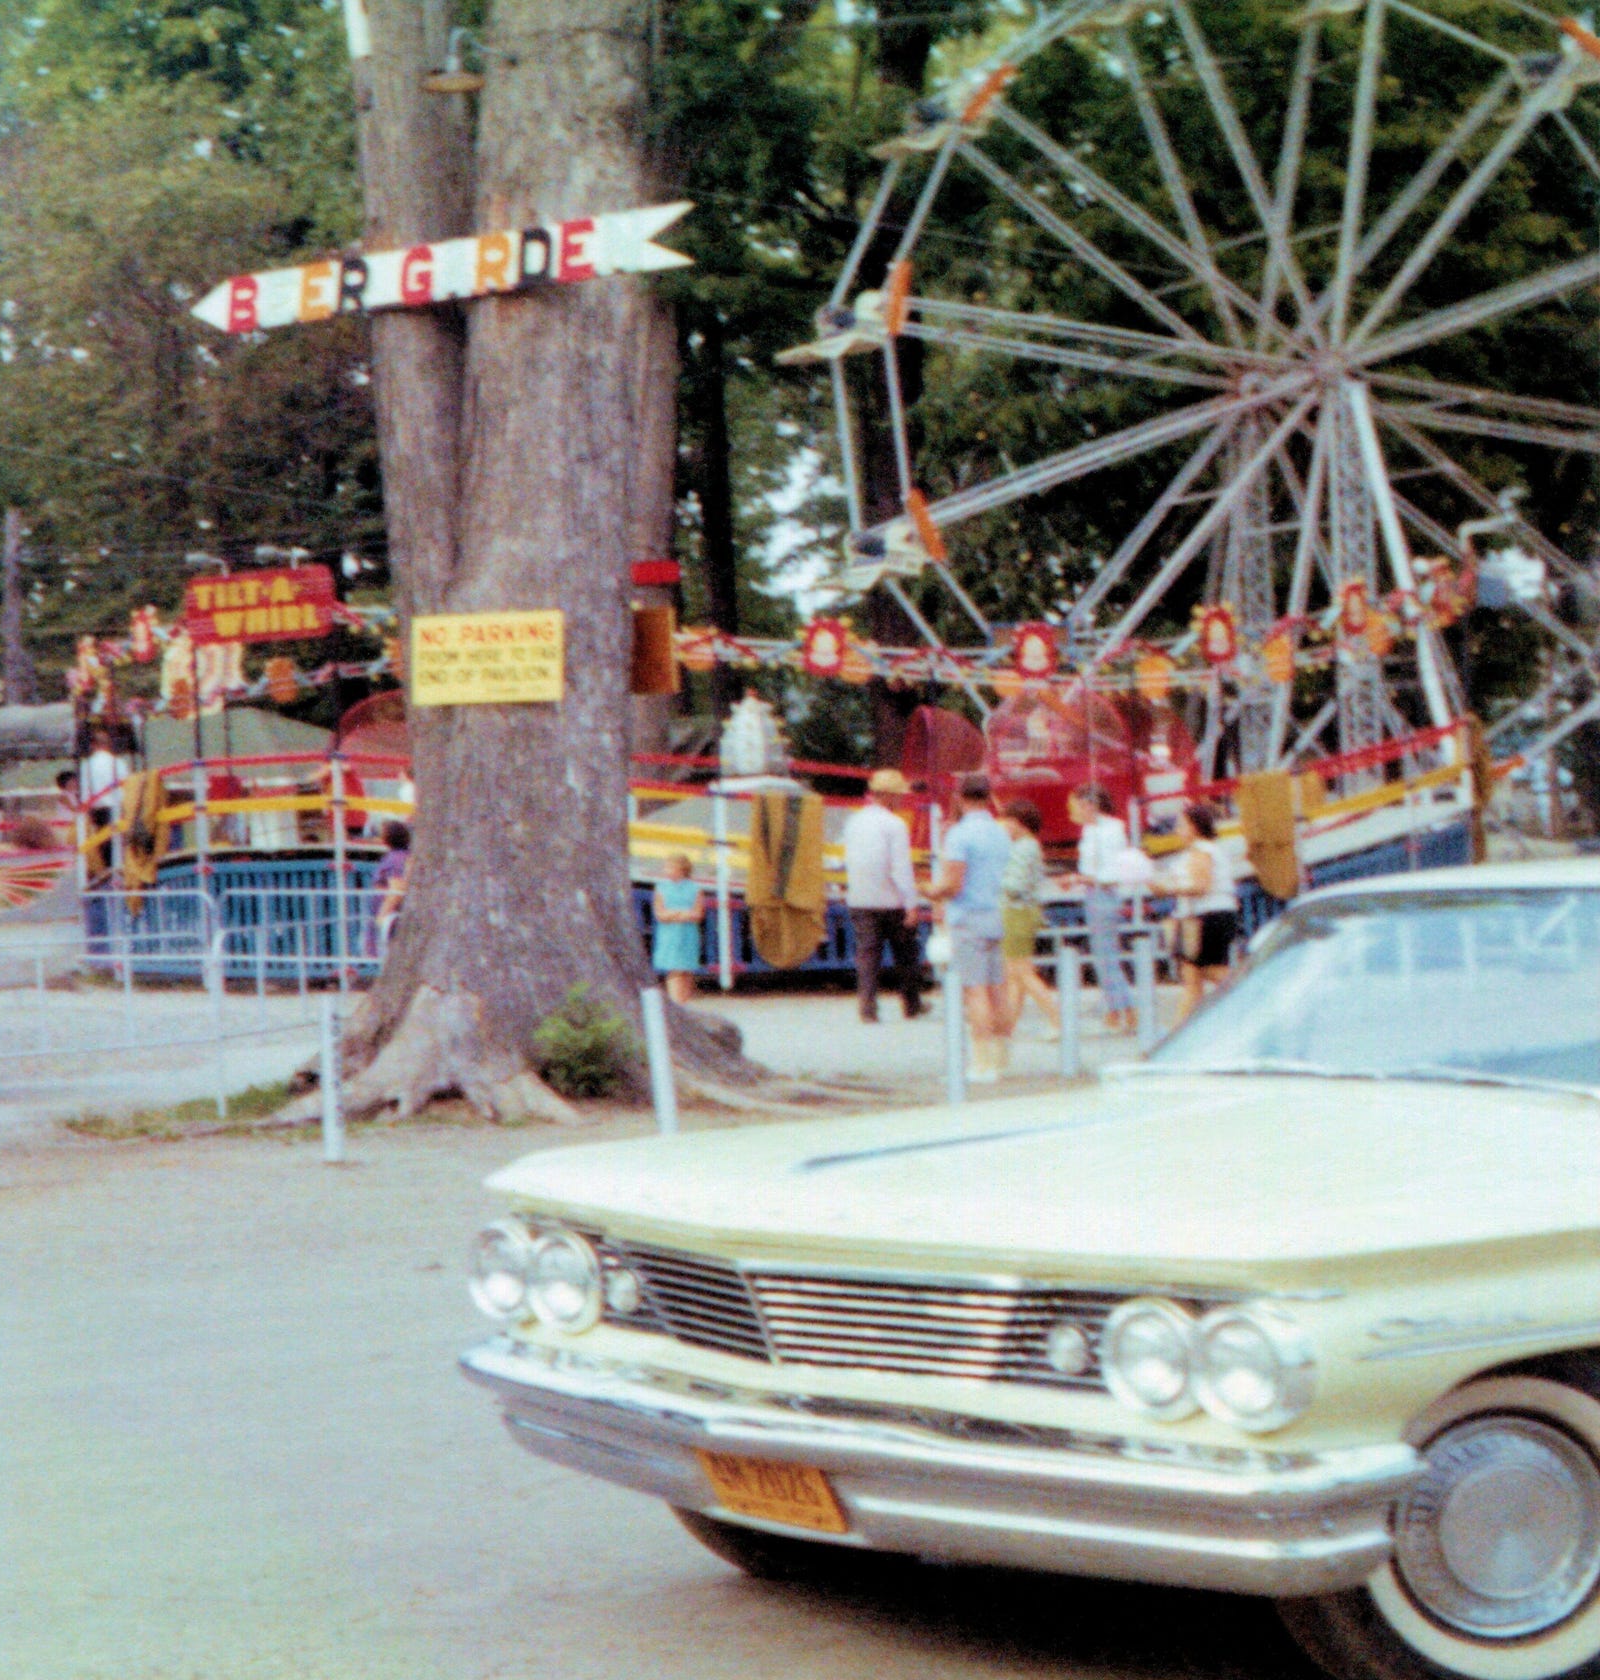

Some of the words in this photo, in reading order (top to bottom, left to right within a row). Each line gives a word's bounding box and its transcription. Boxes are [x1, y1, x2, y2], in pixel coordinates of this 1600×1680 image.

[213, 603, 320, 637] WHIRL
[419, 626, 447, 645] NO
[460, 619, 554, 642] PARKING
[418, 650, 459, 666] FROM
[417, 669, 448, 686] END
[454, 668, 473, 684] OF
